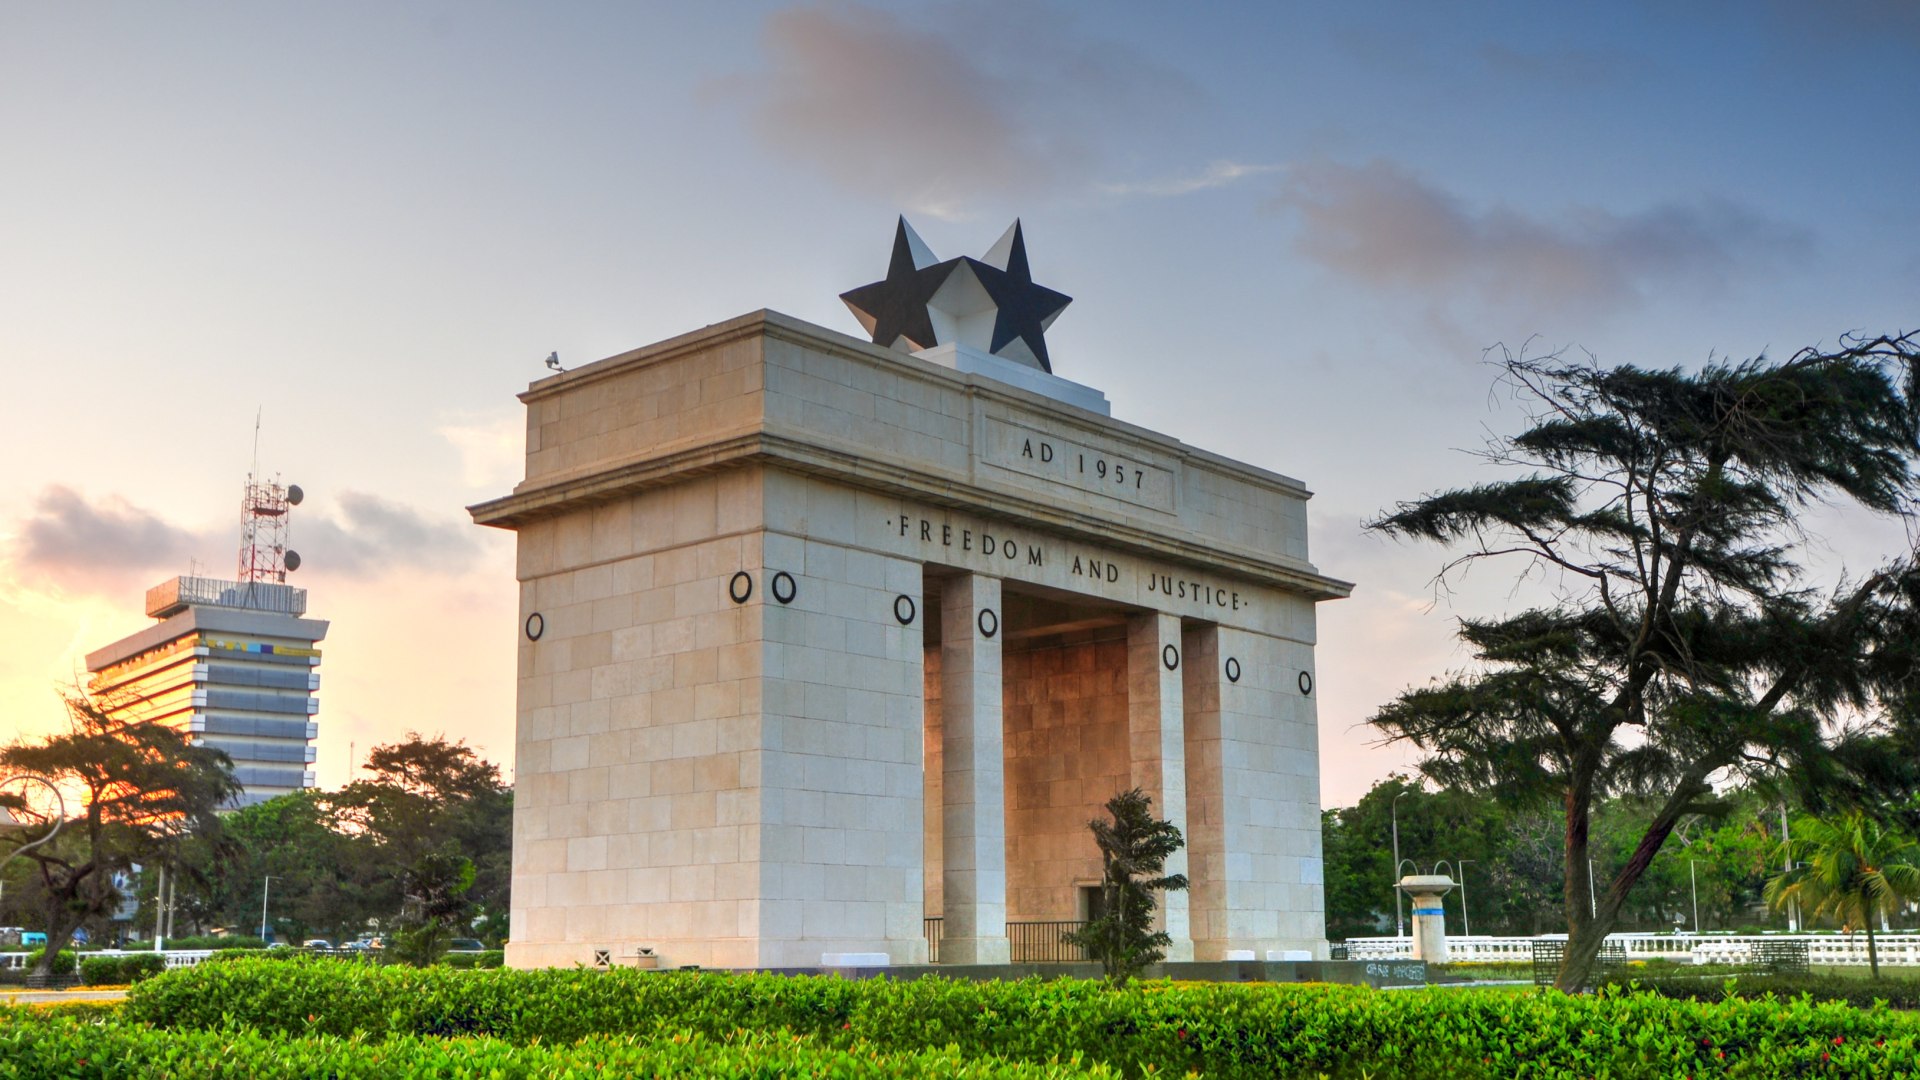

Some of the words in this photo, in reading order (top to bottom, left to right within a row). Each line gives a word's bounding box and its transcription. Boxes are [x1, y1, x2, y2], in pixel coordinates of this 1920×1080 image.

[1022, 438, 1053, 463] AD
[1079, 454, 1143, 489] 1957
[1072, 555, 1118, 583] AND
